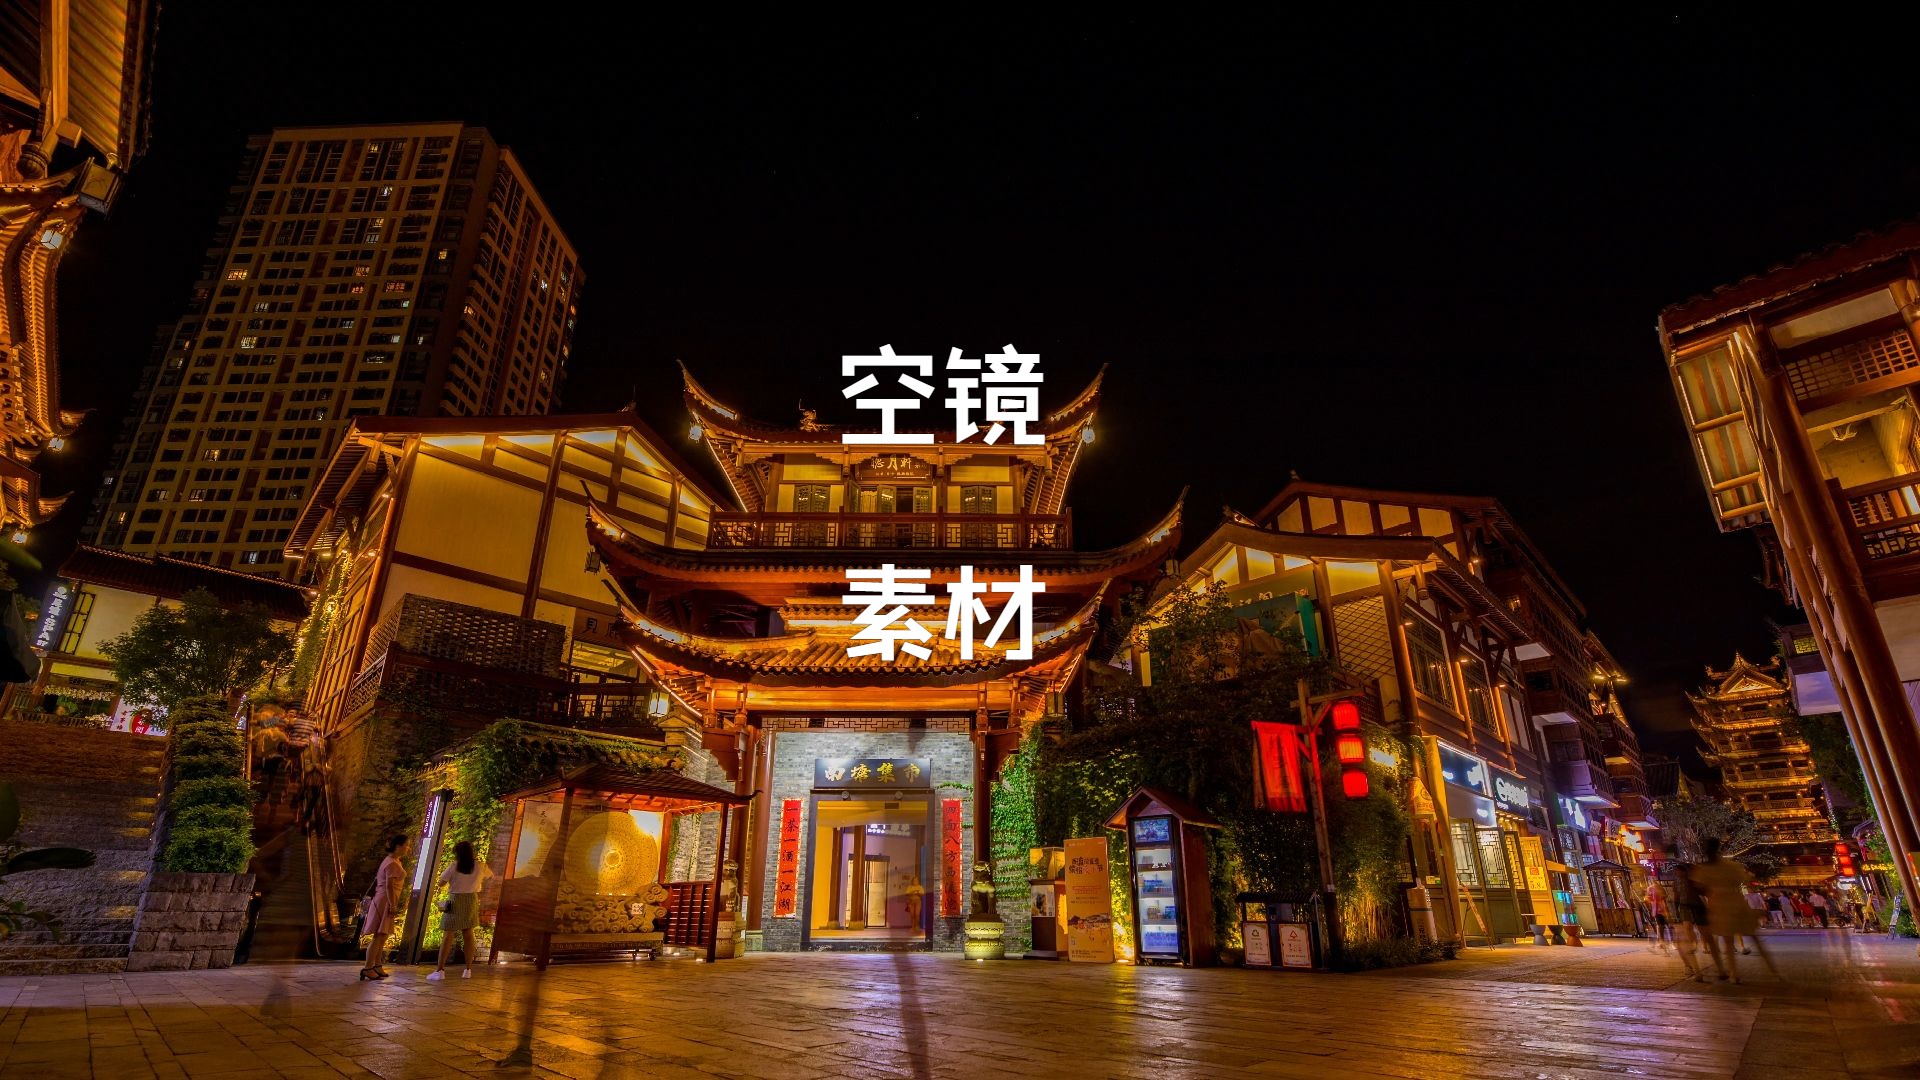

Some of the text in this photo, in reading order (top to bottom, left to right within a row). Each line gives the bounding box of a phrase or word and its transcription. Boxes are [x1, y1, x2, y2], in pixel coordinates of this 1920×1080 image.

[778, 806, 799, 912] 一茶一酒一江湖
